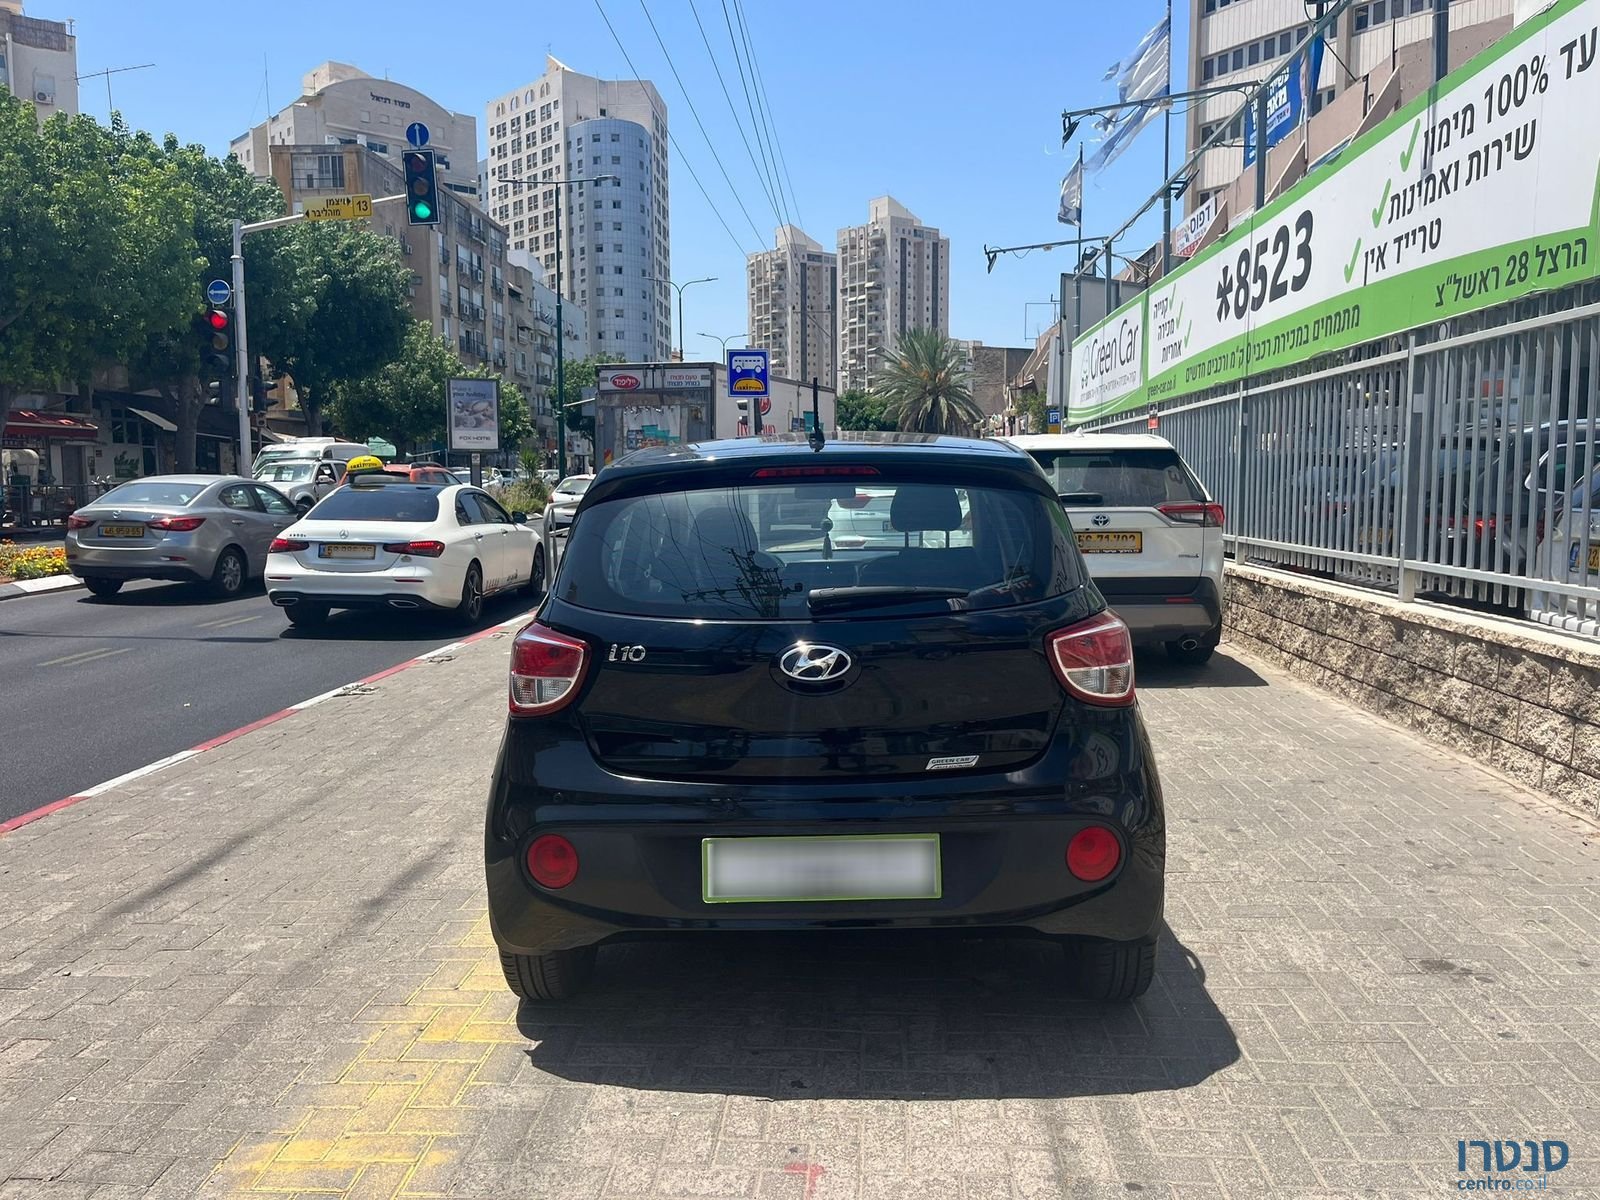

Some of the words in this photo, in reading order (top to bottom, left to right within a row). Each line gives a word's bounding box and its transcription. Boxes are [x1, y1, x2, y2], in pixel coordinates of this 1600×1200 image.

[1559, 26, 1598, 80] עד
[1484, 55, 1549, 124] 100%
[1422, 103, 1475, 170] מימון
[1465, 118, 1537, 186] שירות
[356, 200, 369, 212] 13
[1388, 160, 1460, 224] ואמינות
[1190, 205, 1210, 233] דפוס
[1393, 217, 1442, 265] טרייד
[1535, 238, 1588, 277] הרצל
[1363, 242, 1388, 287] אין
[1505, 251, 1529, 287] 28
[1158, 318, 1175, 341] מכירה
[1273, 324, 1309, 356] במכירת
[1312, 304, 1360, 341] מתמחים
[1091, 338, 1117, 380] Green
[1119, 318, 1139, 366] Car
[609, 643, 646, 662] i10
